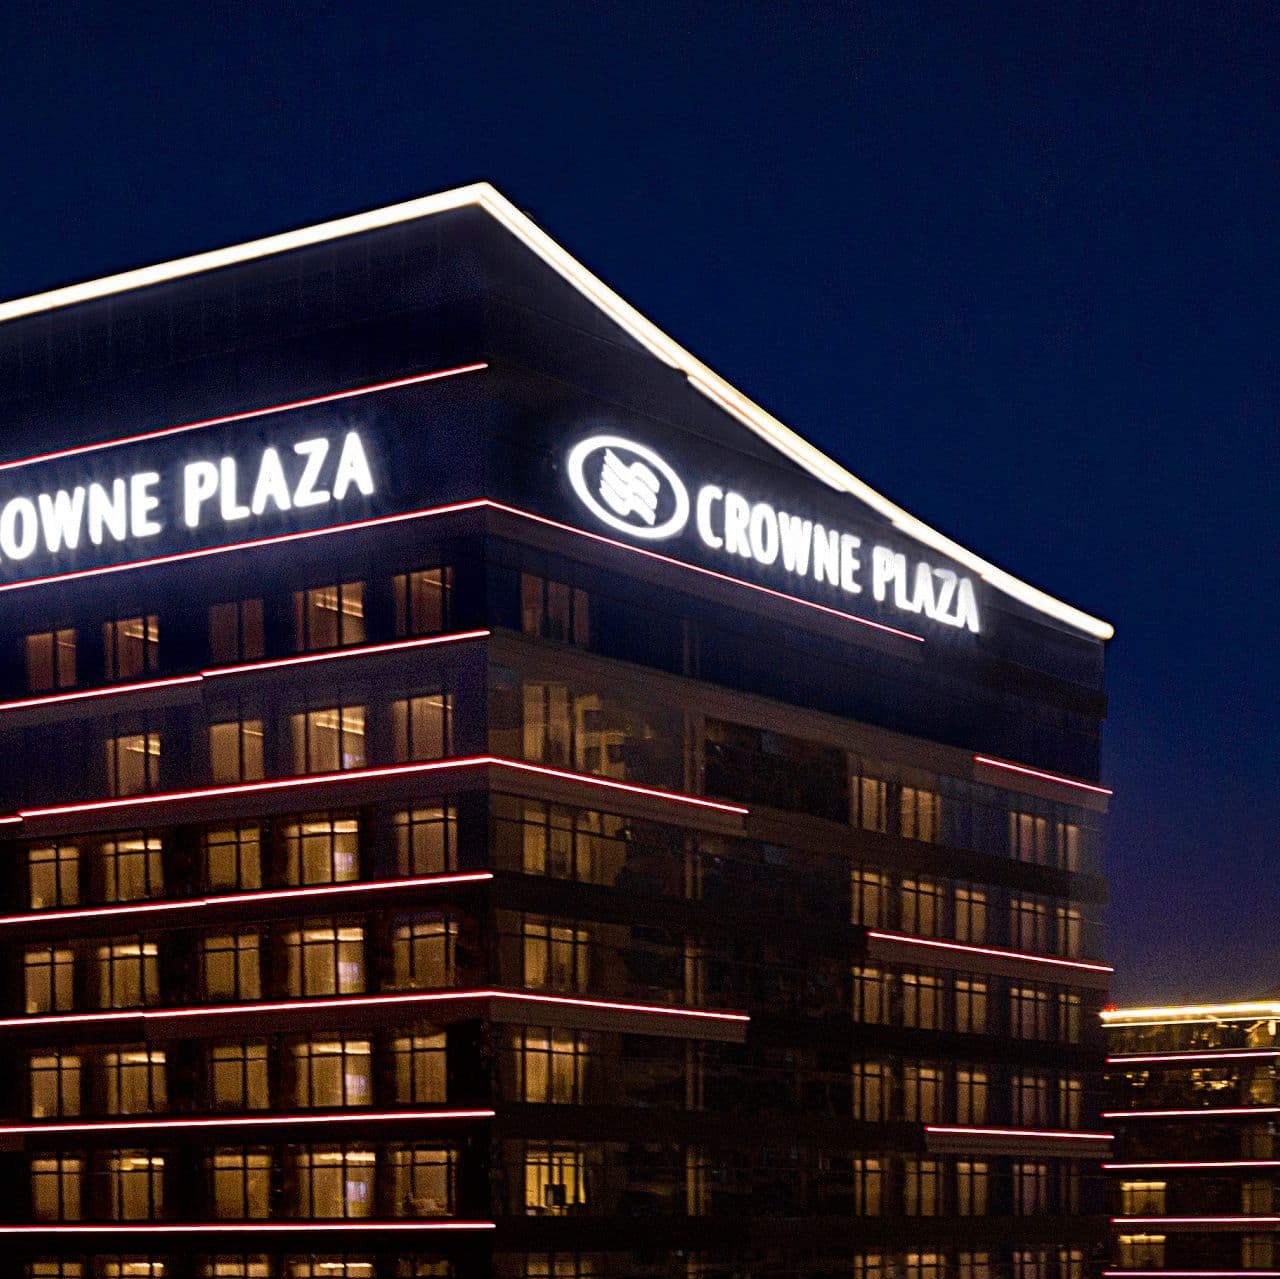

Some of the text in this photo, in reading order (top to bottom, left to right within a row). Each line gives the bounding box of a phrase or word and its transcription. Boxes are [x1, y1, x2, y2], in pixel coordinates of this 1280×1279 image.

[182, 431, 376, 528] PLAZA
[696, 484, 981, 634] CROWNE PLAZA
